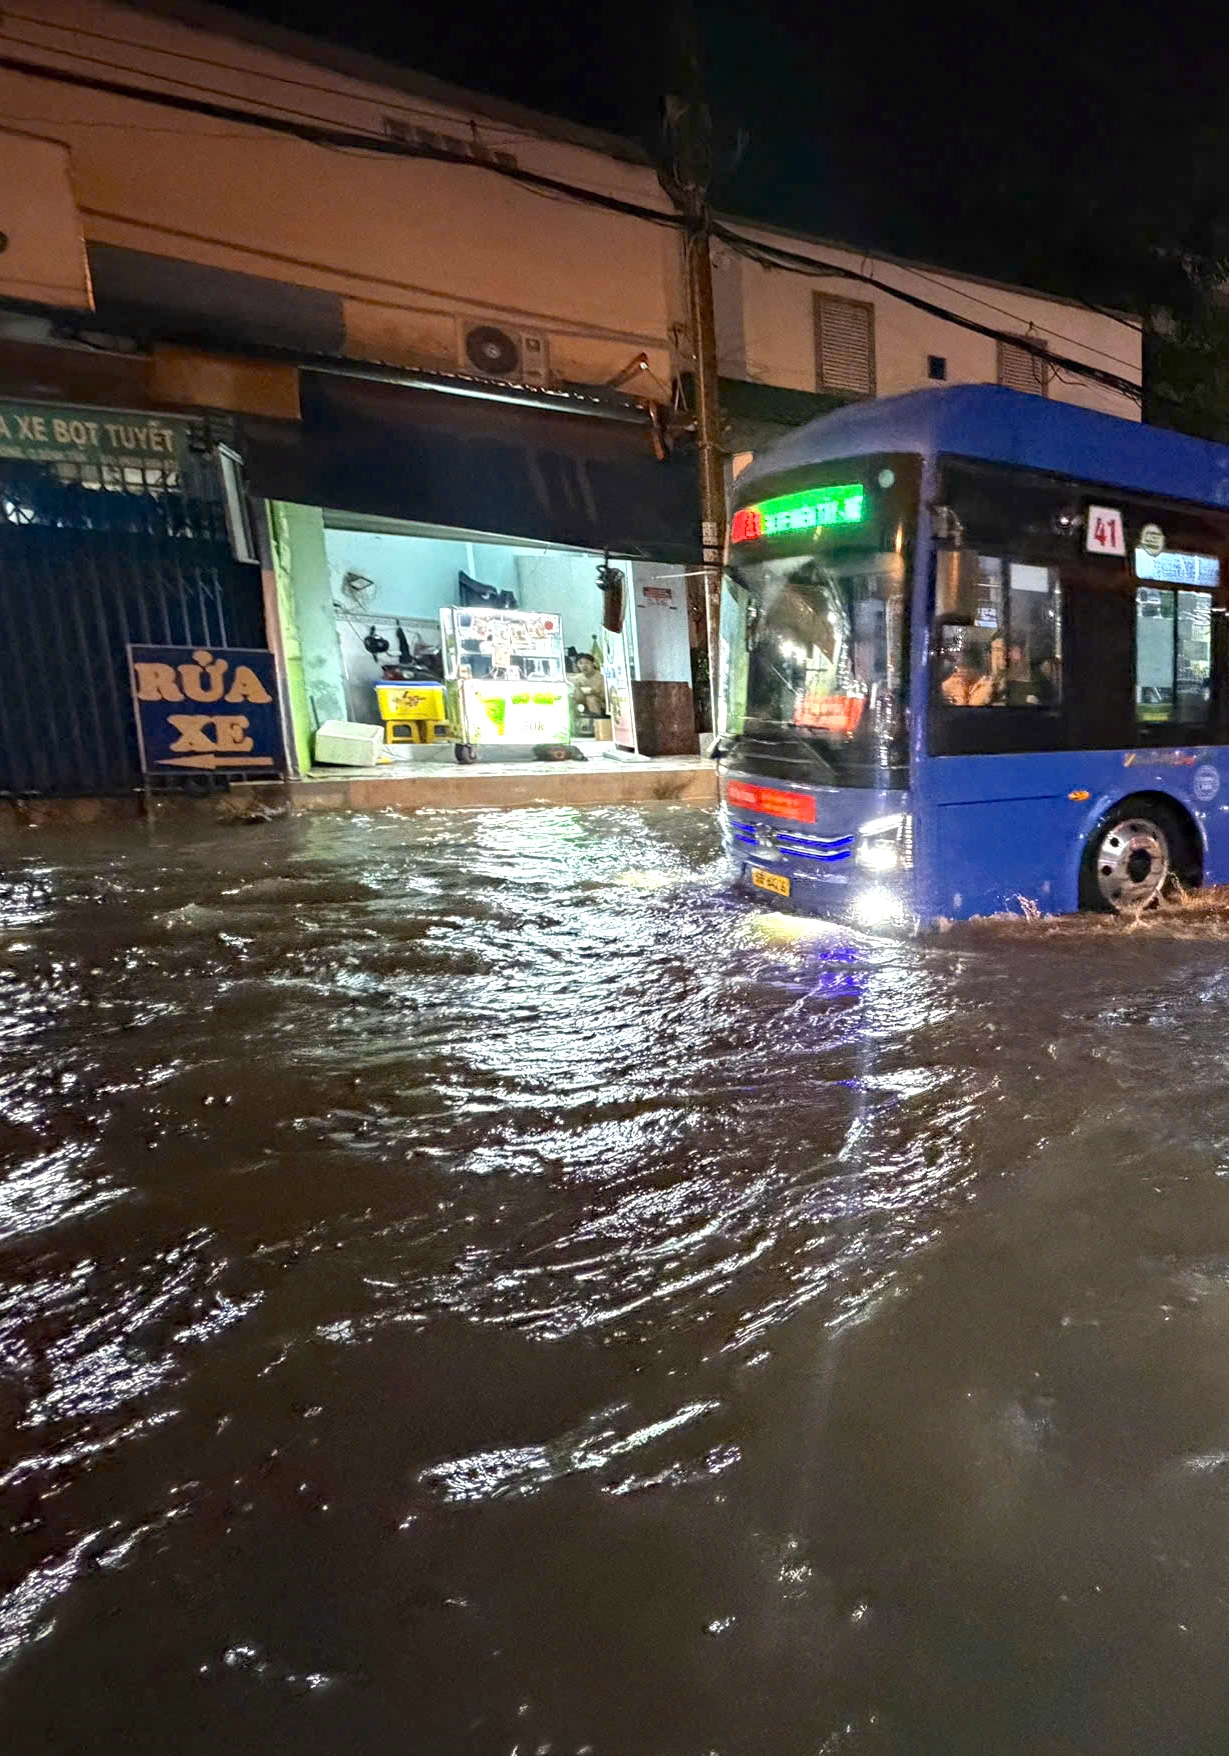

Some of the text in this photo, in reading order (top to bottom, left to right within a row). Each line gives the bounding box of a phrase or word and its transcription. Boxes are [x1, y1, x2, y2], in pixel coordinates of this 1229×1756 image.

[14, 415, 48, 441] XE
[1095, 517, 1116, 547] 41
[134, 650, 273, 703] RỬA
[167, 714, 254, 752] XE
